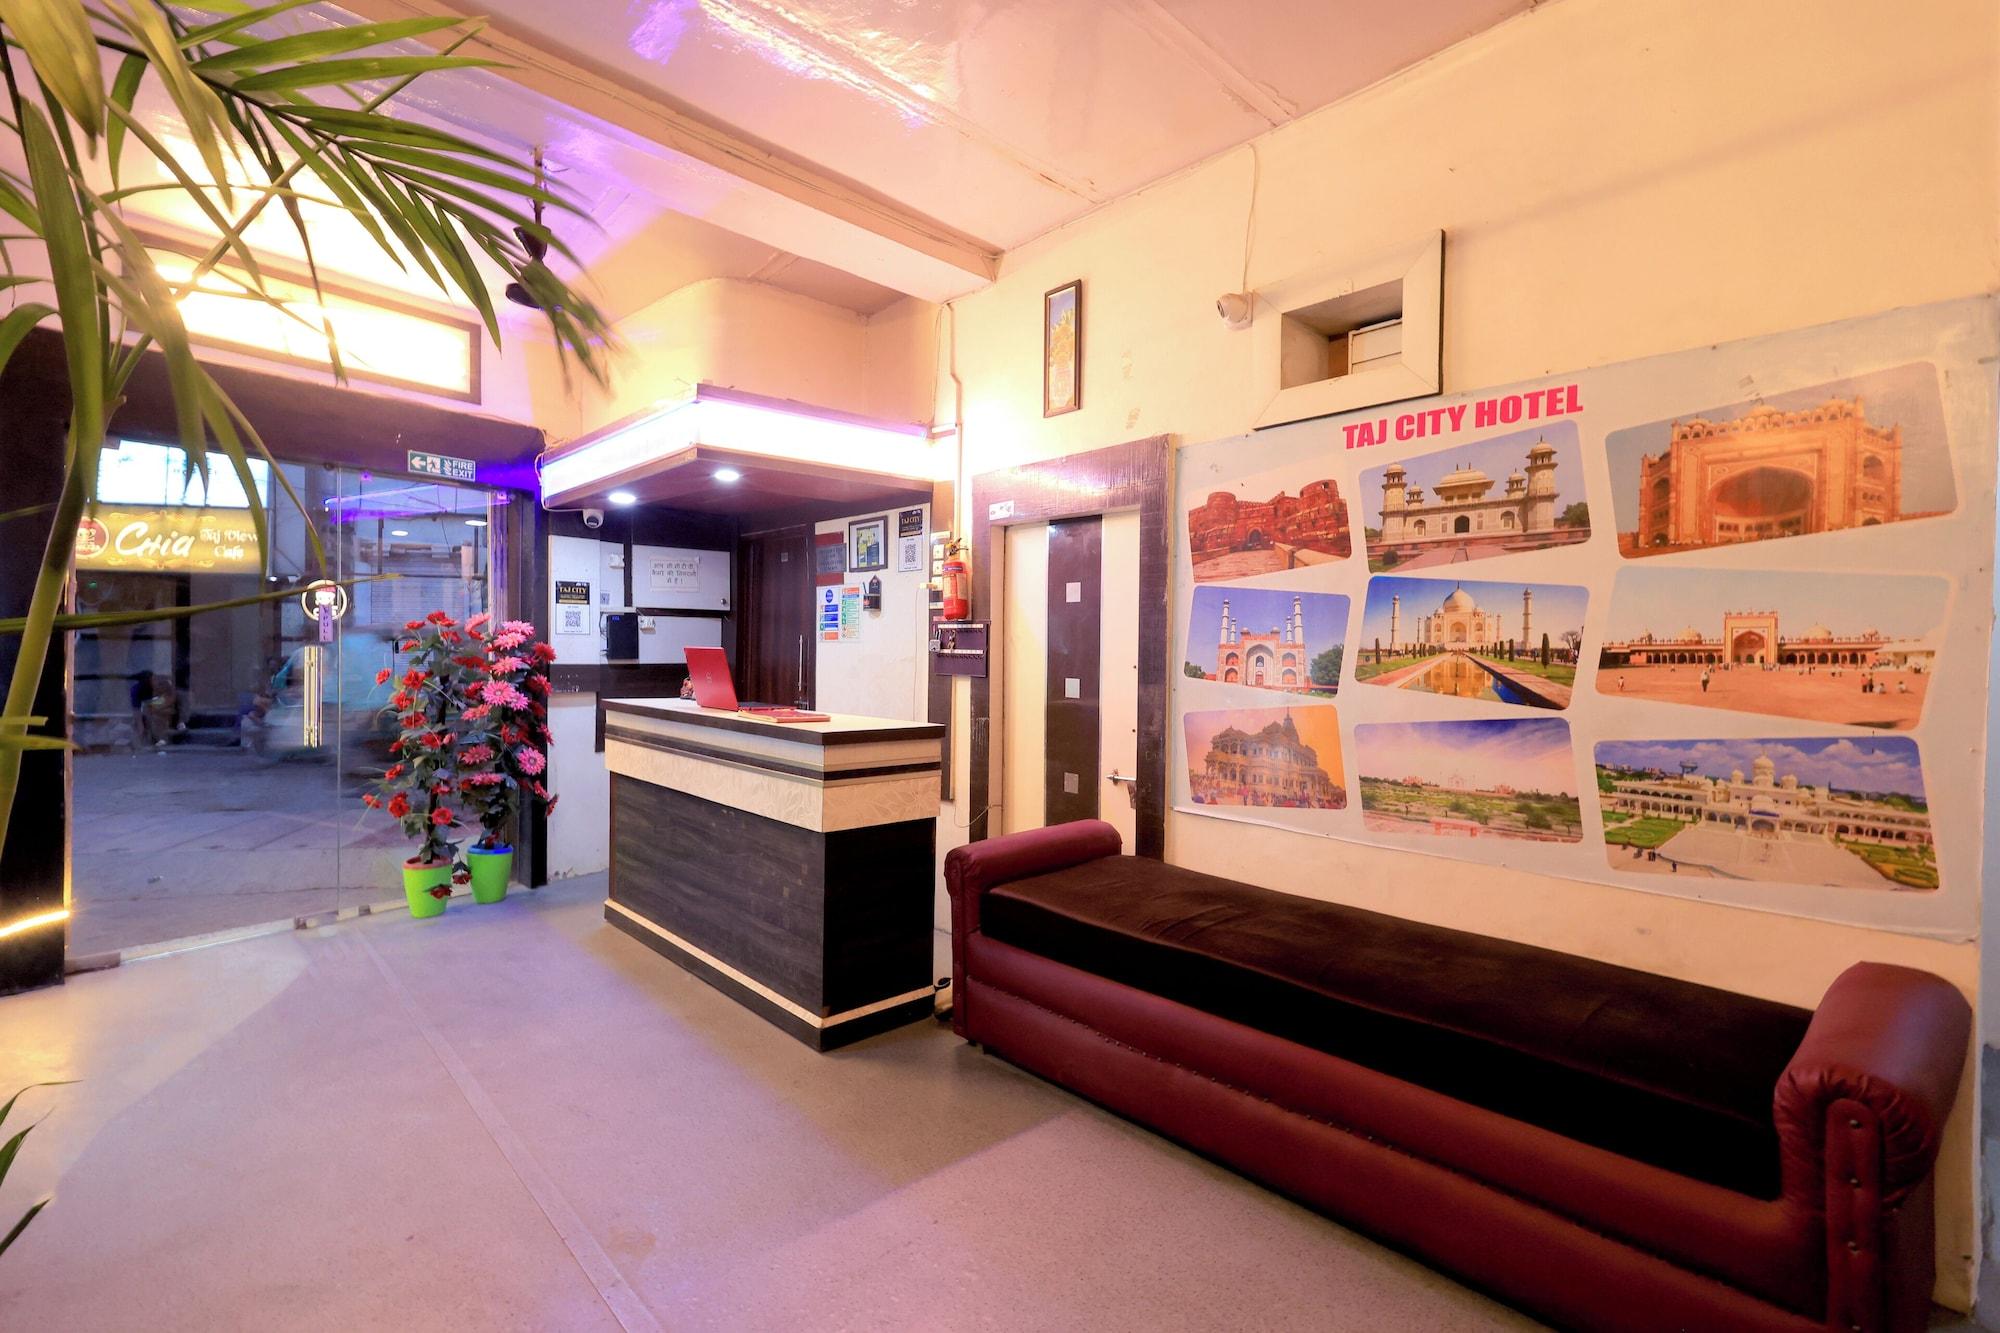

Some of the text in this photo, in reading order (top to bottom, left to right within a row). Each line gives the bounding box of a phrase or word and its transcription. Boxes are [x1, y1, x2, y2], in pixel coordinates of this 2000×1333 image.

[1342, 384, 1583, 450] TAJ CITY HOTEL
[452, 461, 473, 470] FIRE
[452, 469, 473, 478] EXIT
